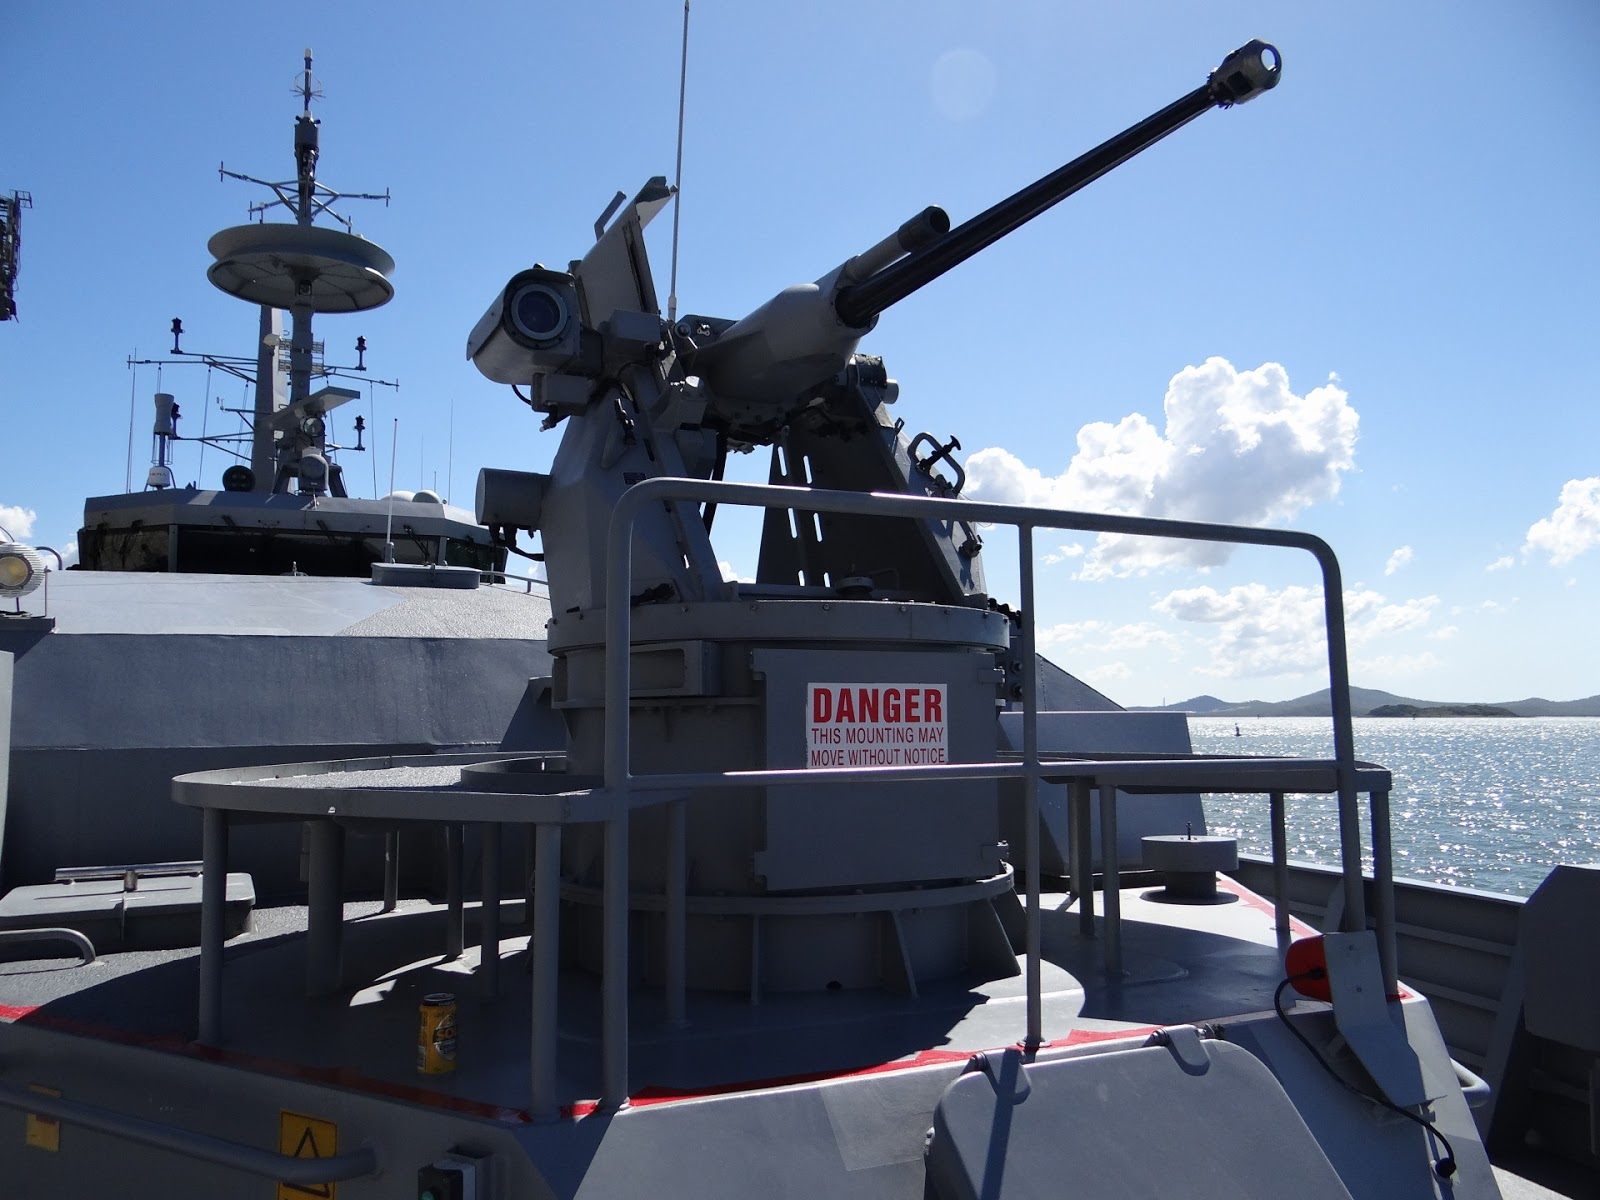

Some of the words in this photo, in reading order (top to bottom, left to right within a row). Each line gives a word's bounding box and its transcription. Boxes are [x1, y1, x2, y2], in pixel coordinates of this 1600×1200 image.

[813, 688, 942, 723] DANGER
[811, 728, 841, 744] THIS
[845, 727, 914, 744] MOUNTING
[918, 727, 944, 743] MAY
[811, 749, 844, 766] MOVE
[848, 748, 901, 766] WITHOUT
[904, 748, 945, 764] NOTICE
